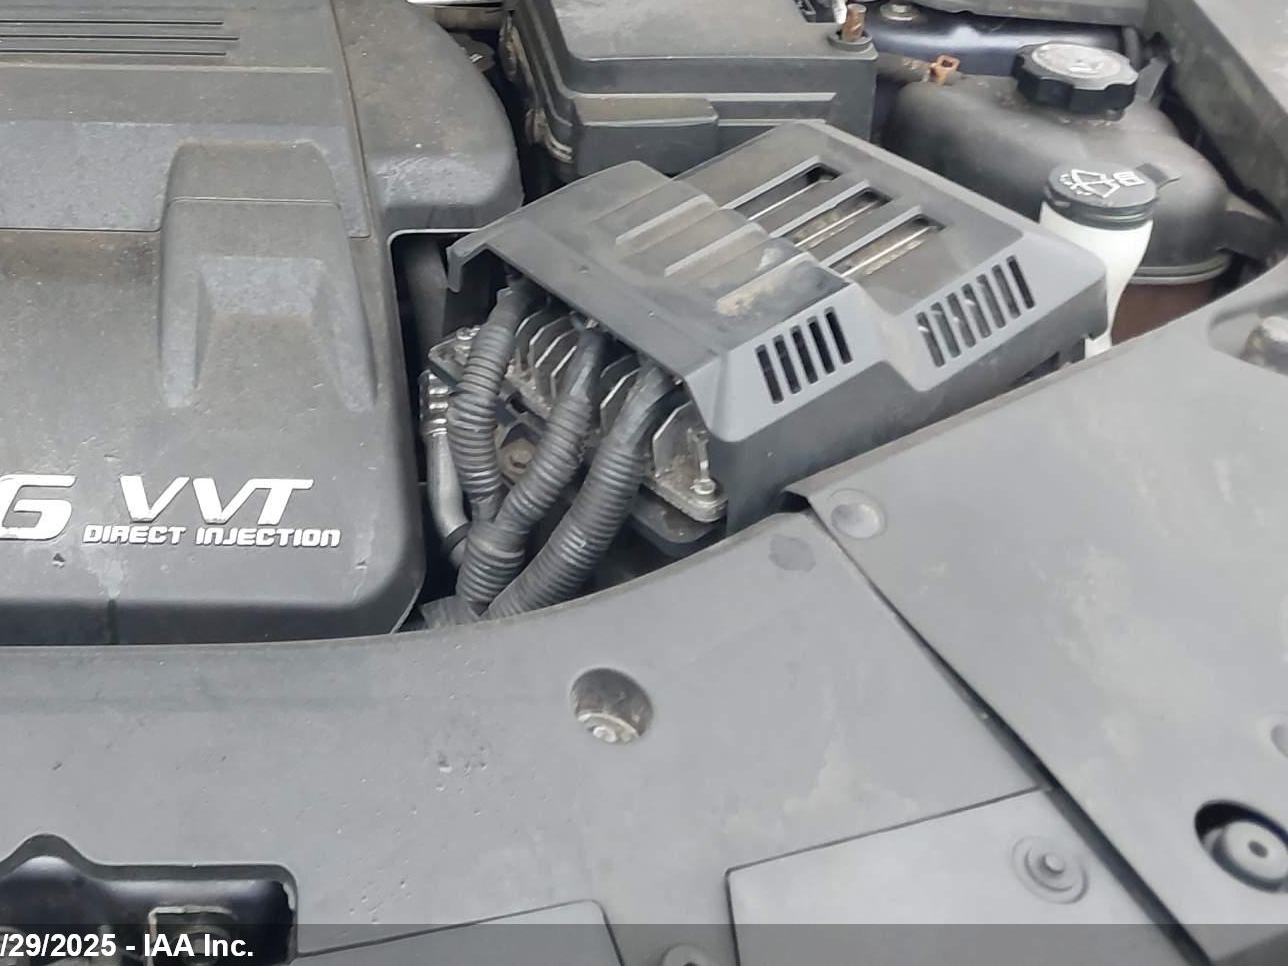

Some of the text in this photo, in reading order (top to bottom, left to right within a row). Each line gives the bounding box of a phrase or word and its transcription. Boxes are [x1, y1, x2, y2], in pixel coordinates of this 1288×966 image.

[120, 475, 314, 525] VVT
[82, 524, 341, 548] DIRECT INJECTION
